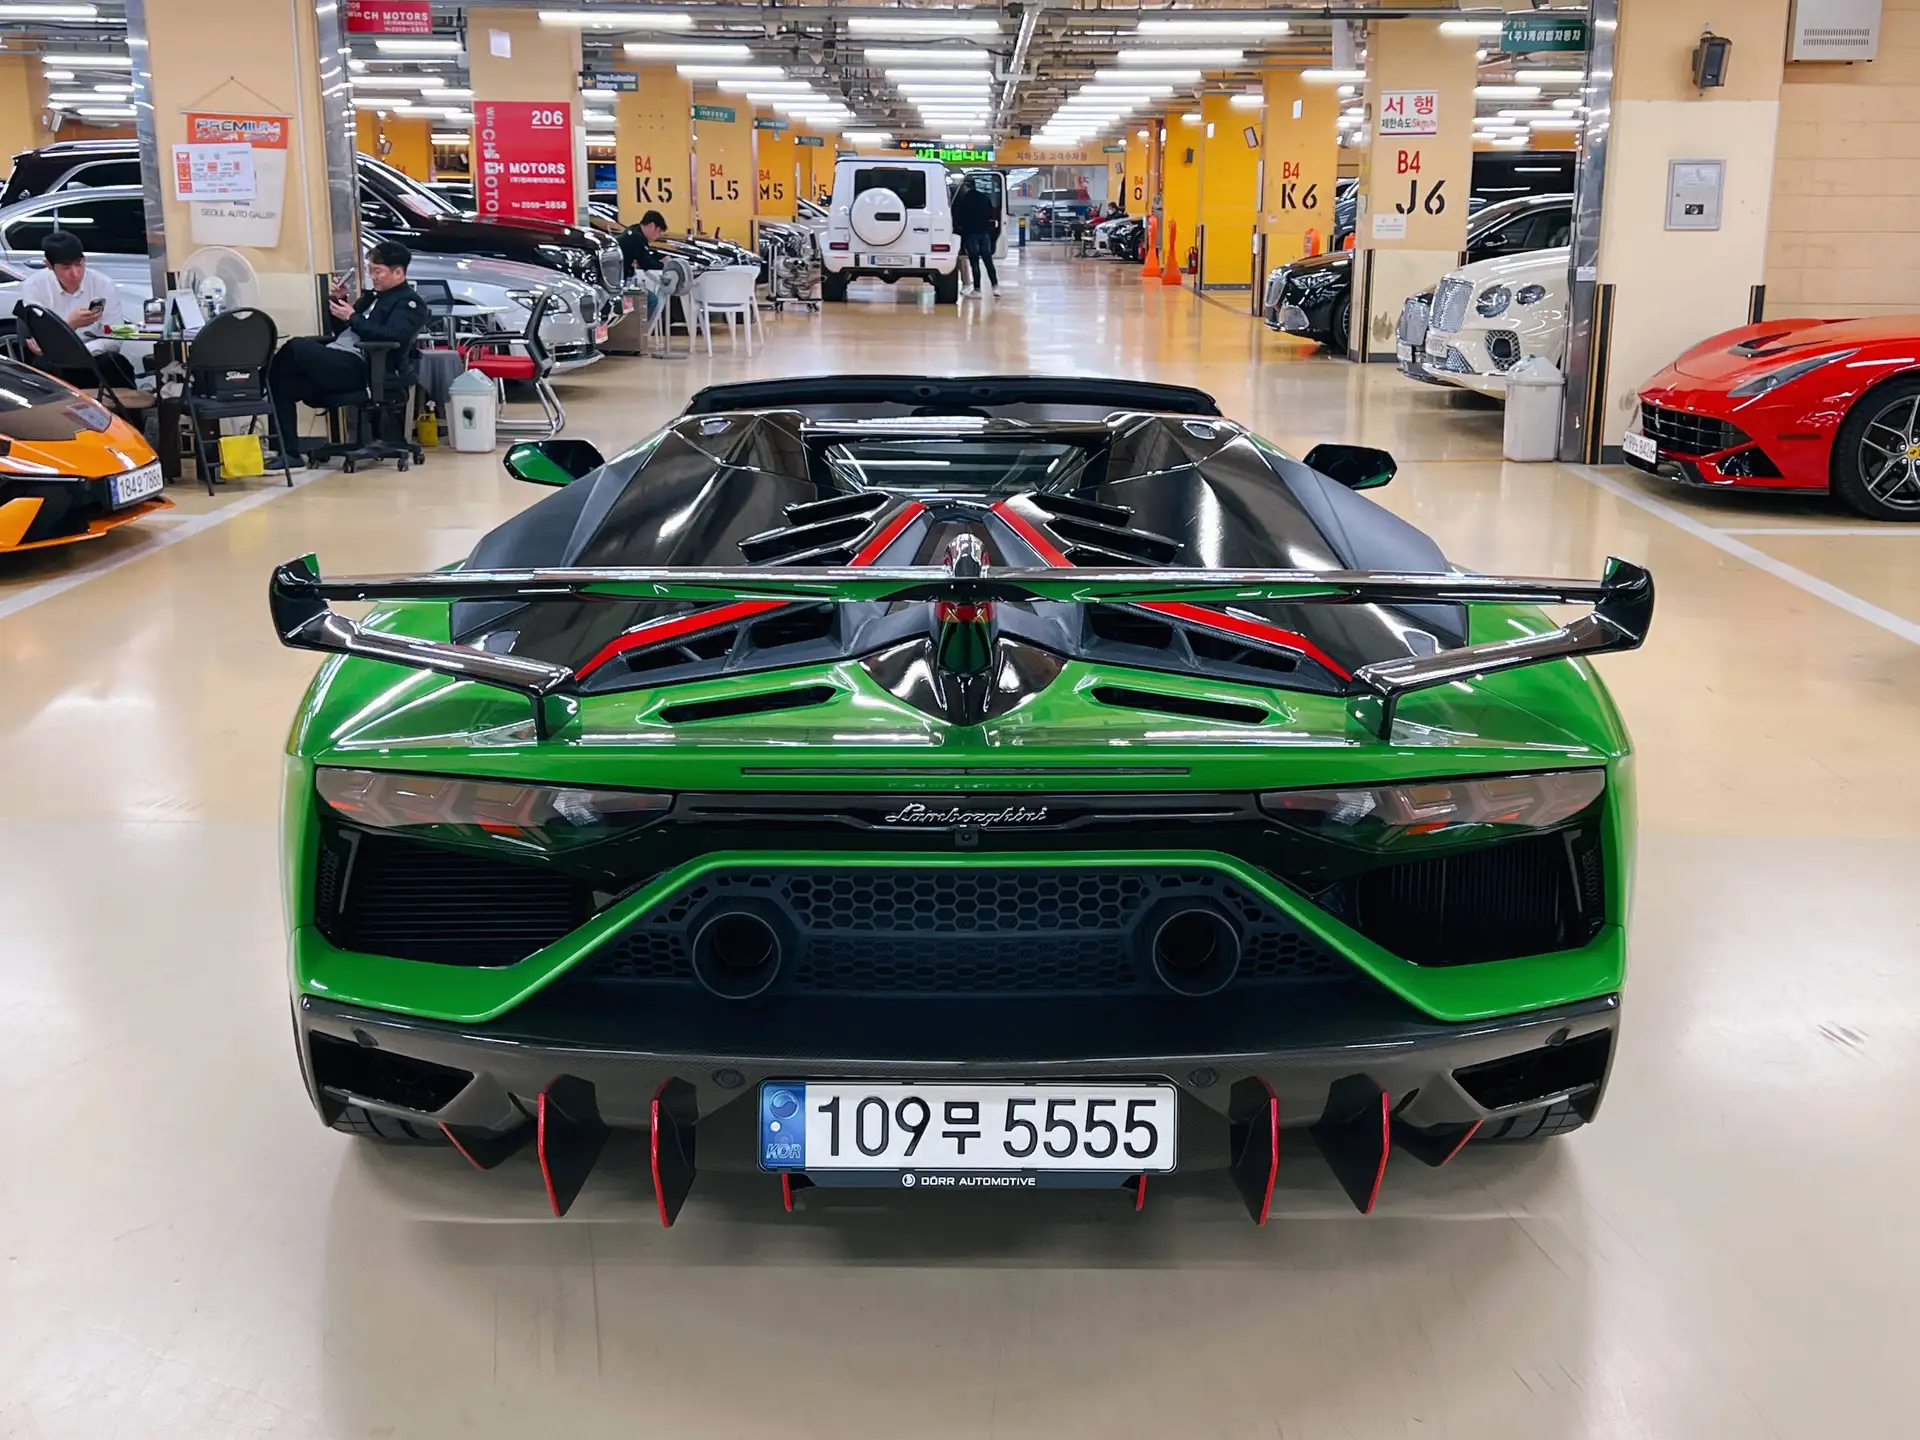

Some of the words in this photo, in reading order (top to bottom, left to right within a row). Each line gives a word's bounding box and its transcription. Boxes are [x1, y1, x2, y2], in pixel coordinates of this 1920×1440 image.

[363, 11, 379, 20] CH
[383, 11, 429, 21] MOTORS
[531, 110, 564, 126] 206
[509, 162, 566, 175] MOTORS
[635, 155, 652, 173] B4
[709, 163, 724, 177] B4
[1282, 161, 1300, 180] B4
[1397, 150, 1421, 174] B4
[759, 170, 770, 181] B4
[635, 177, 673, 203] K5
[710, 180, 739, 201] L5
[759, 183, 784, 200] M5
[1281, 183, 1318, 210] K6
[1395, 179, 1446, 215] J6
[200, 209, 225, 217] SEOUL
[228, 210, 247, 219] AUTO
[884, 802, 1048, 827] Lamborghini
[818, 1096, 981, 1157] 109무
[1003, 1098, 1159, 1159] 5555
[766, 1143, 802, 1160] KOR
[921, 1175, 955, 1186] DÖRR
[958, 1176, 1036, 1186] AUTOMOTIVE
